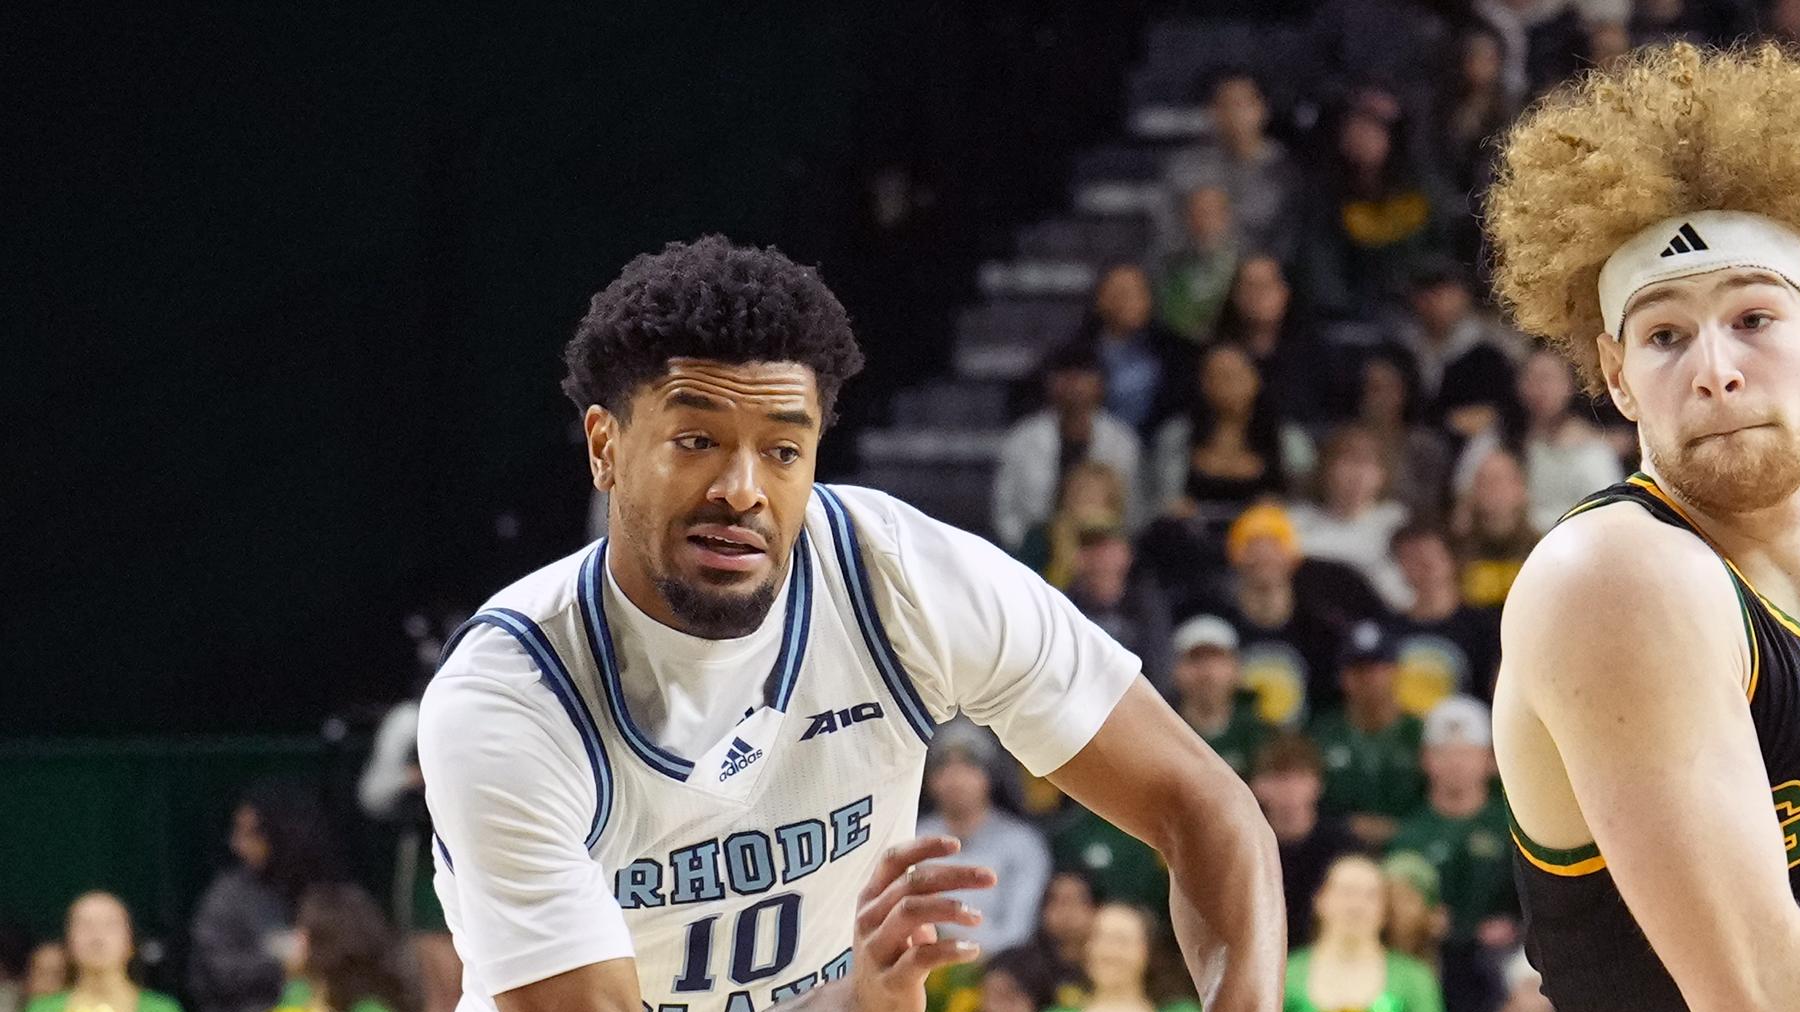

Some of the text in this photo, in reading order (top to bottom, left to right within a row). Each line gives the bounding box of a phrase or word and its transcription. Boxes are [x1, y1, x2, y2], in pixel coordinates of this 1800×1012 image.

[798, 701, 885, 742] A10
[719, 748, 763, 783] adidas
[614, 794, 873, 909] RHODE
[671, 889, 804, 993] 10
